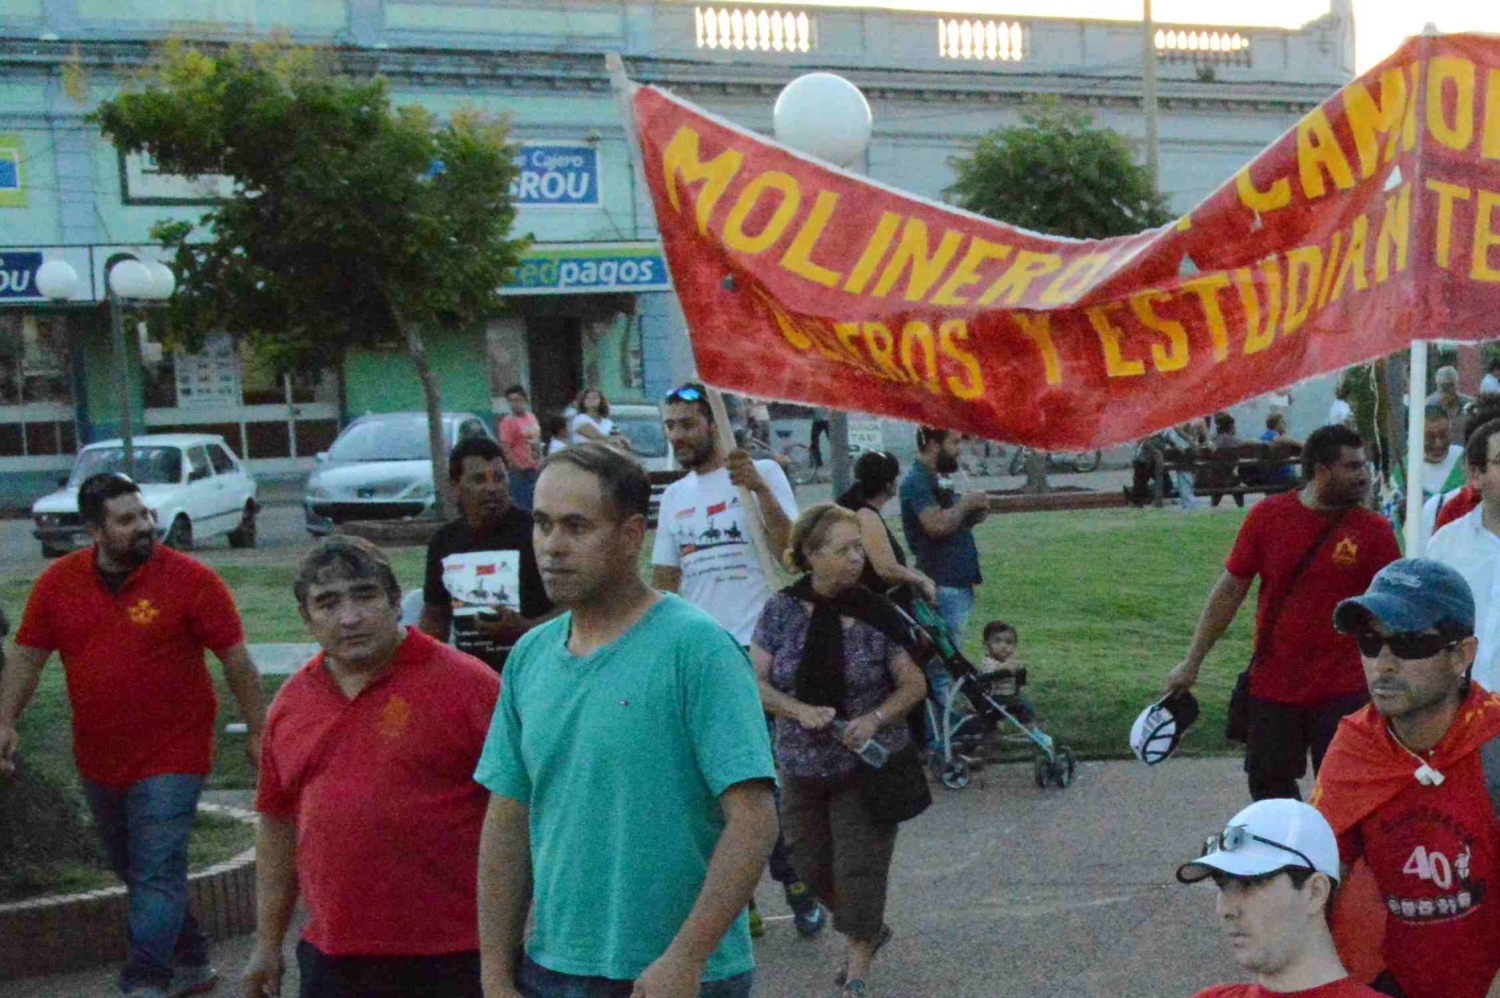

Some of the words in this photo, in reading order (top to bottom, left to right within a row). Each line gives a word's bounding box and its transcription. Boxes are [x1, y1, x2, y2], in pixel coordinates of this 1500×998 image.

[510, 170, 590, 199] ROU
[513, 254, 654, 288] edpagos
[1012, 312, 1063, 387] Y
[1402, 845, 1452, 890] 40
